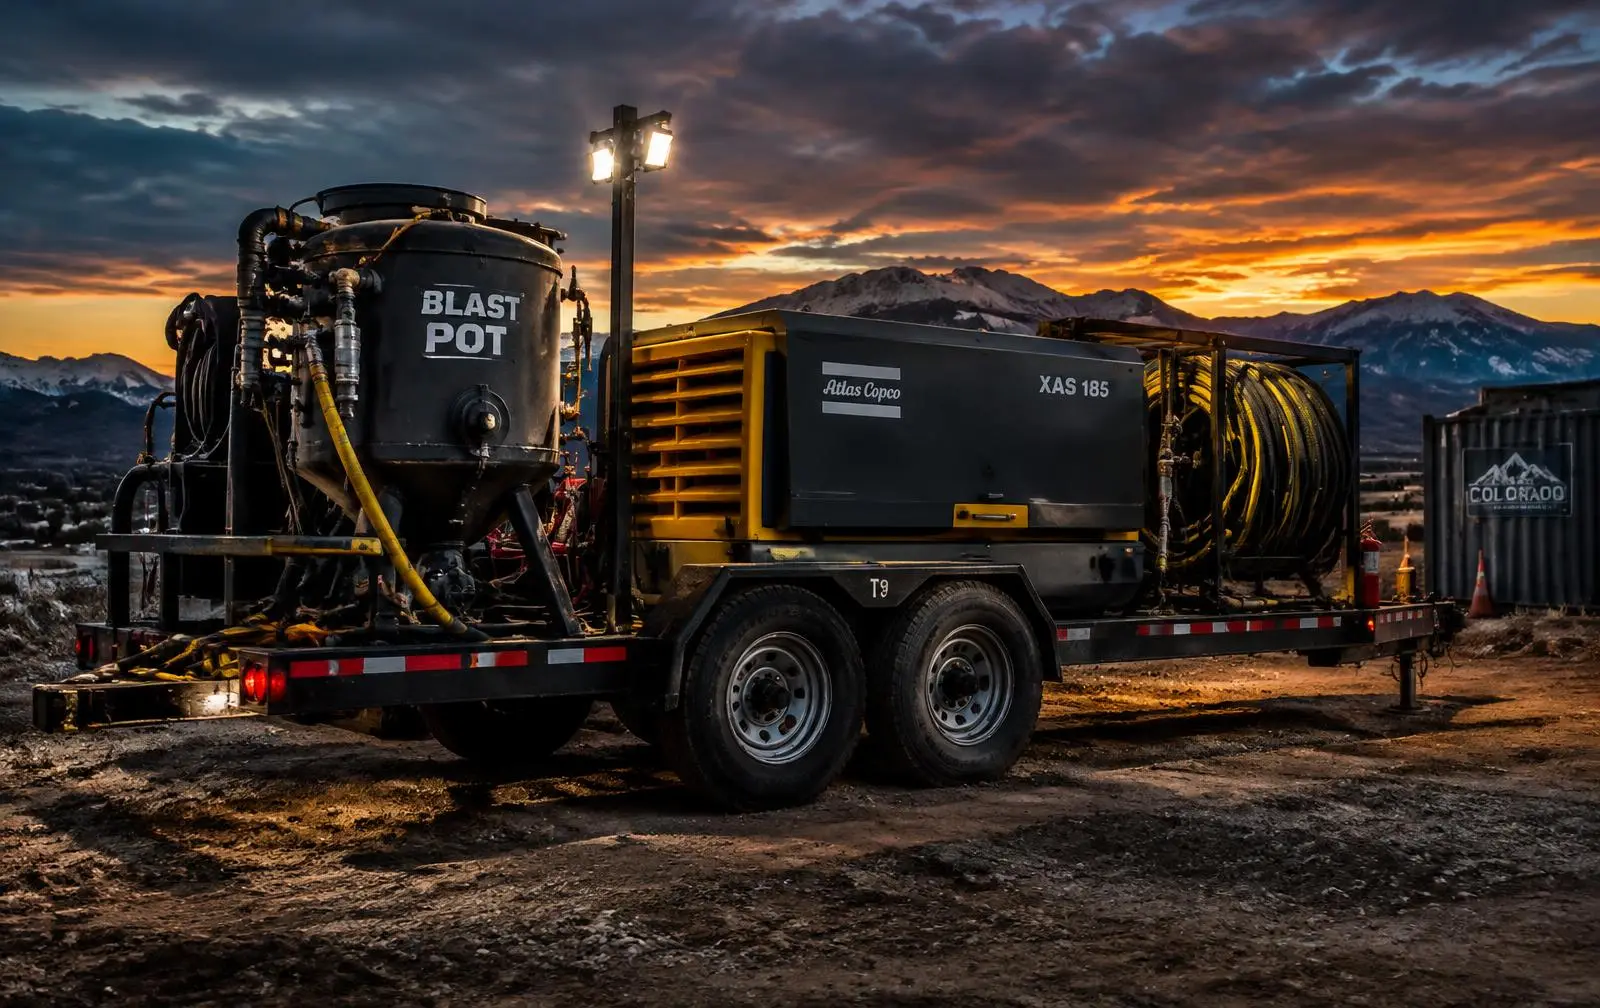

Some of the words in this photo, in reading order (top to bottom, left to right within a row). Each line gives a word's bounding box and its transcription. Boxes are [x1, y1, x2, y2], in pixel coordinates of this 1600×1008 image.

[421, 290, 520, 321] BLAST
[425, 322, 507, 356] POT
[823, 379, 862, 397] Atlas
[863, 381, 901, 403] Copco
[1039, 375, 1077, 395] XAS
[1081, 380, 1109, 398] 185
[870, 578, 889, 598] T9
